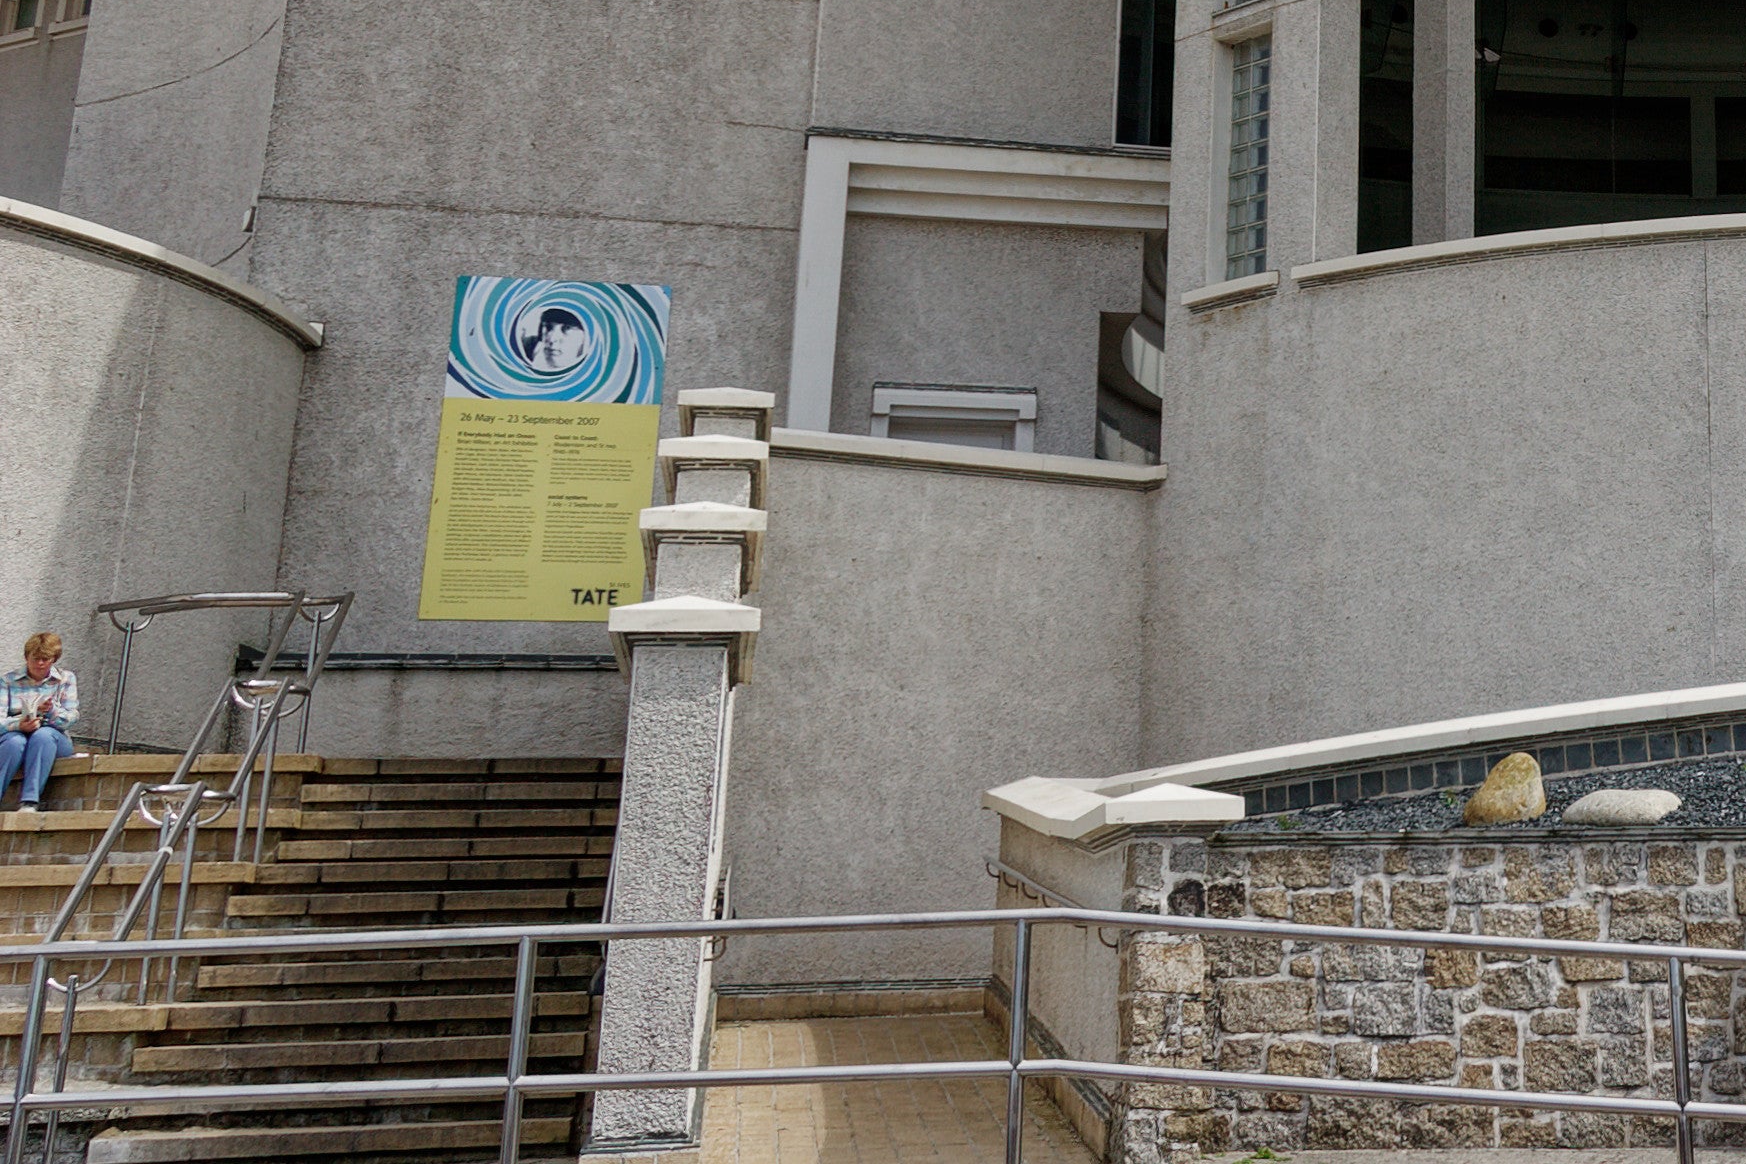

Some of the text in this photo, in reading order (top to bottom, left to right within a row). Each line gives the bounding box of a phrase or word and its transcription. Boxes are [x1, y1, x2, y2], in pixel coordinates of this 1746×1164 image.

[460, 413, 472, 422] 26
[474, 413, 495, 424] May
[507, 414, 519, 423] 23
[522, 415, 574, 426] September
[577, 416, 600, 426] 2007
[571, 588, 619, 605] TATE
